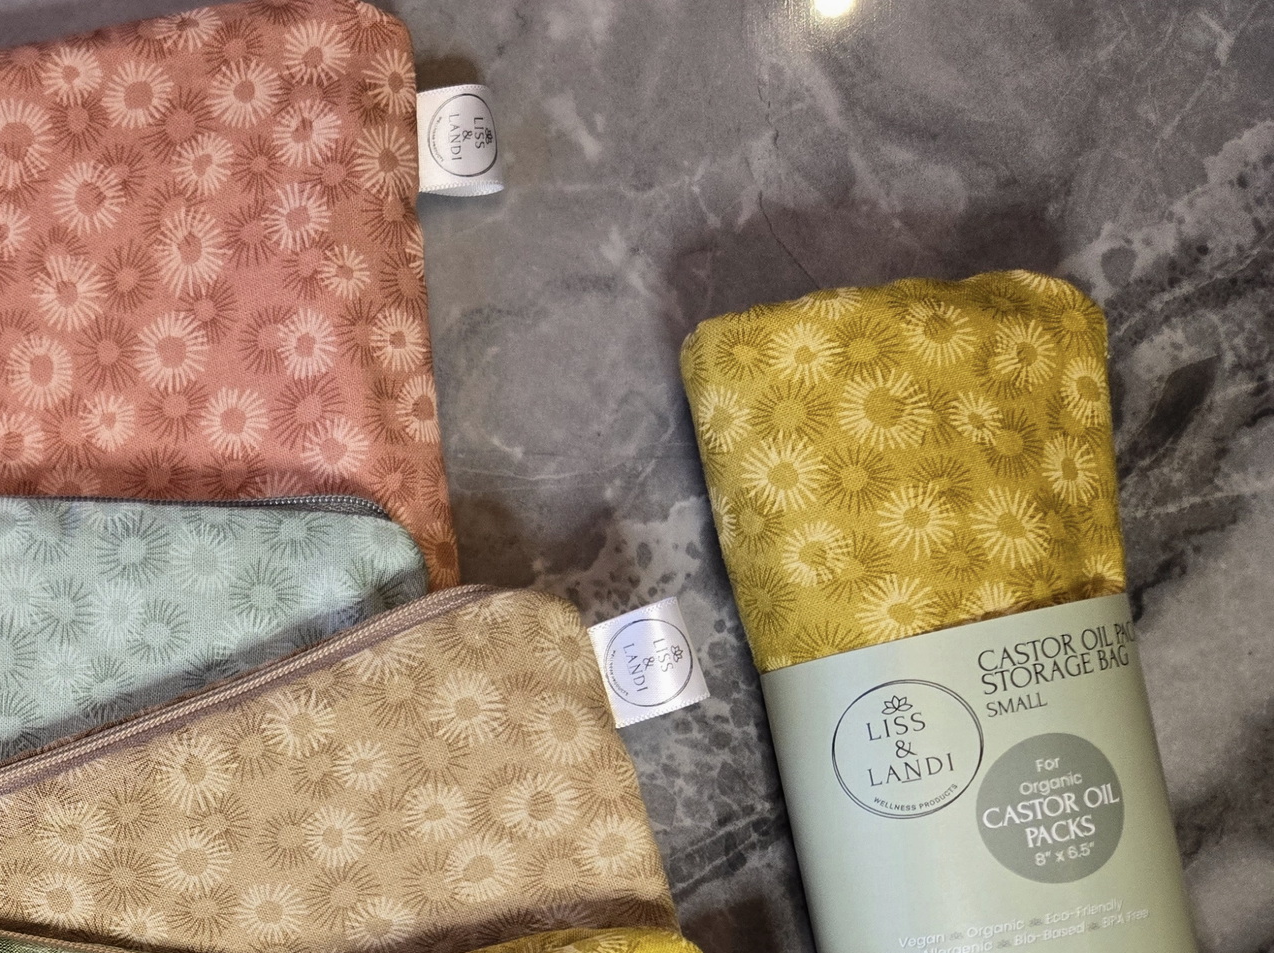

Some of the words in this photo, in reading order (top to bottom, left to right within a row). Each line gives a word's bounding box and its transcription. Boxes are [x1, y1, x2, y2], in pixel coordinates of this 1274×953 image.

[448, 113, 462, 161] LANDI
[462, 130, 473, 141] &
[473, 117, 485, 149] LISS
[653, 638, 674, 672] LISS
[978, 633, 1076, 672] CASTOR
[1081, 625, 1113, 651] OIL
[1113, 620, 1136, 644] PAC
[623, 642, 648, 692] LANDI
[642, 656, 655, 671] &
[981, 652, 1094, 695] STORAGE
[1097, 645, 1129, 671] BAG
[986, 692, 1048, 718] SMALL
[866, 712, 926, 741] LISS
[895, 740, 918, 759] &
[867, 753, 954, 787] LANDI
[1035, 757, 1060, 773] For
[873, 796, 917, 811] WELLNESS
[919, 783, 958, 809] PRODUCTS
[1019, 771, 1083, 796] Organic
[982, 792, 1079, 829] CASTOR
[1083, 783, 1120, 808] OIL
[1025, 814, 1096, 848] PACKS
[1055, 851, 1065, 863] x
[898, 932, 945, 950] Vegan
[966, 919, 1025, 940] Organic
[1045, 898, 1123, 925] Eco-Friendly
[1014, 920, 1085, 947] Bio-Based
